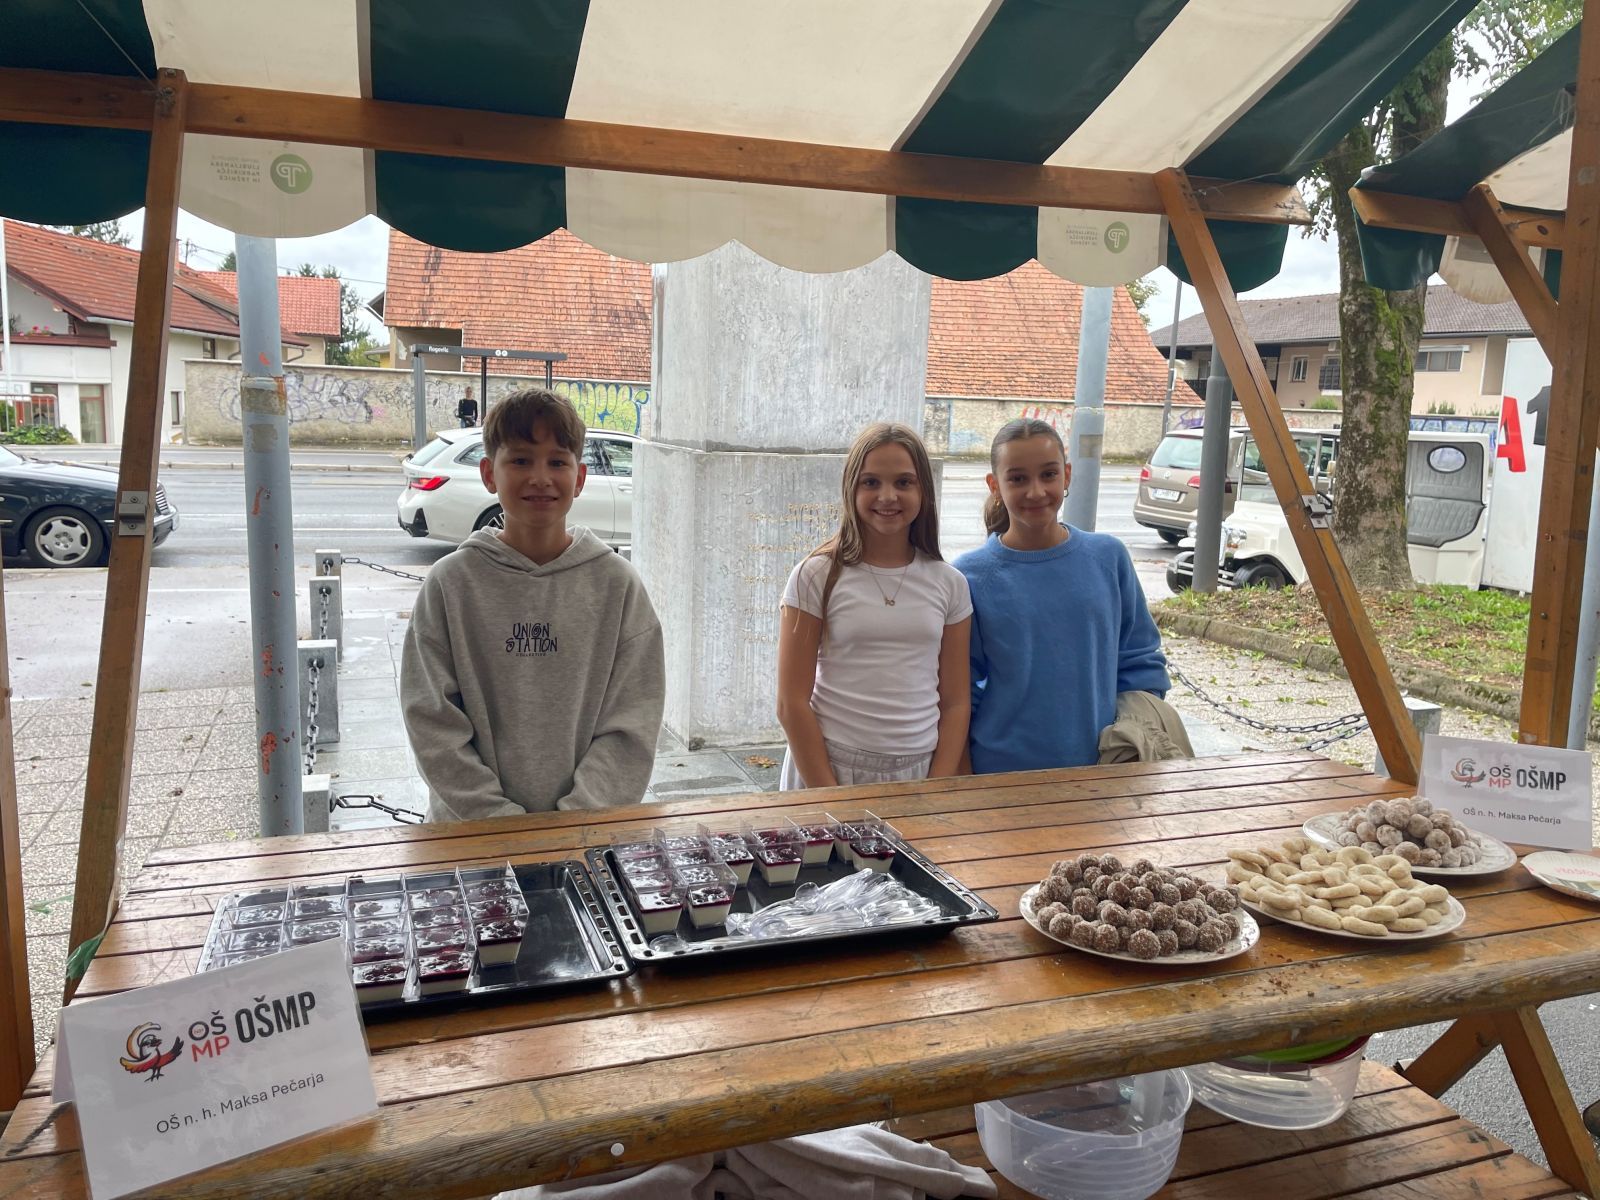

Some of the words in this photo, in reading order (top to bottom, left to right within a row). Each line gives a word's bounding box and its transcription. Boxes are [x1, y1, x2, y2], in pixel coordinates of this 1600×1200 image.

[513, 623, 550, 638] UNION
[506, 637, 558, 652] STATION
[1489, 765, 1511, 778] OŠ
[1516, 765, 1566, 791] OŠMP
[1489, 777, 1511, 788] MP
[1462, 806, 1476, 816] OŠ
[1498, 810, 1526, 821] Maksa
[1528, 812, 1562, 826] Pečarja
[188, 1010, 227, 1041] OŠ
[235, 991, 316, 1044] OŠMP
[192, 1035, 230, 1062] MP
[156, 1113, 181, 1134] OŠ
[183, 1113, 200, 1127] n.
[201, 1106, 217, 1120] h.
[220, 1091, 269, 1115] Maksa
[271, 1071, 325, 1098] Pečarja
